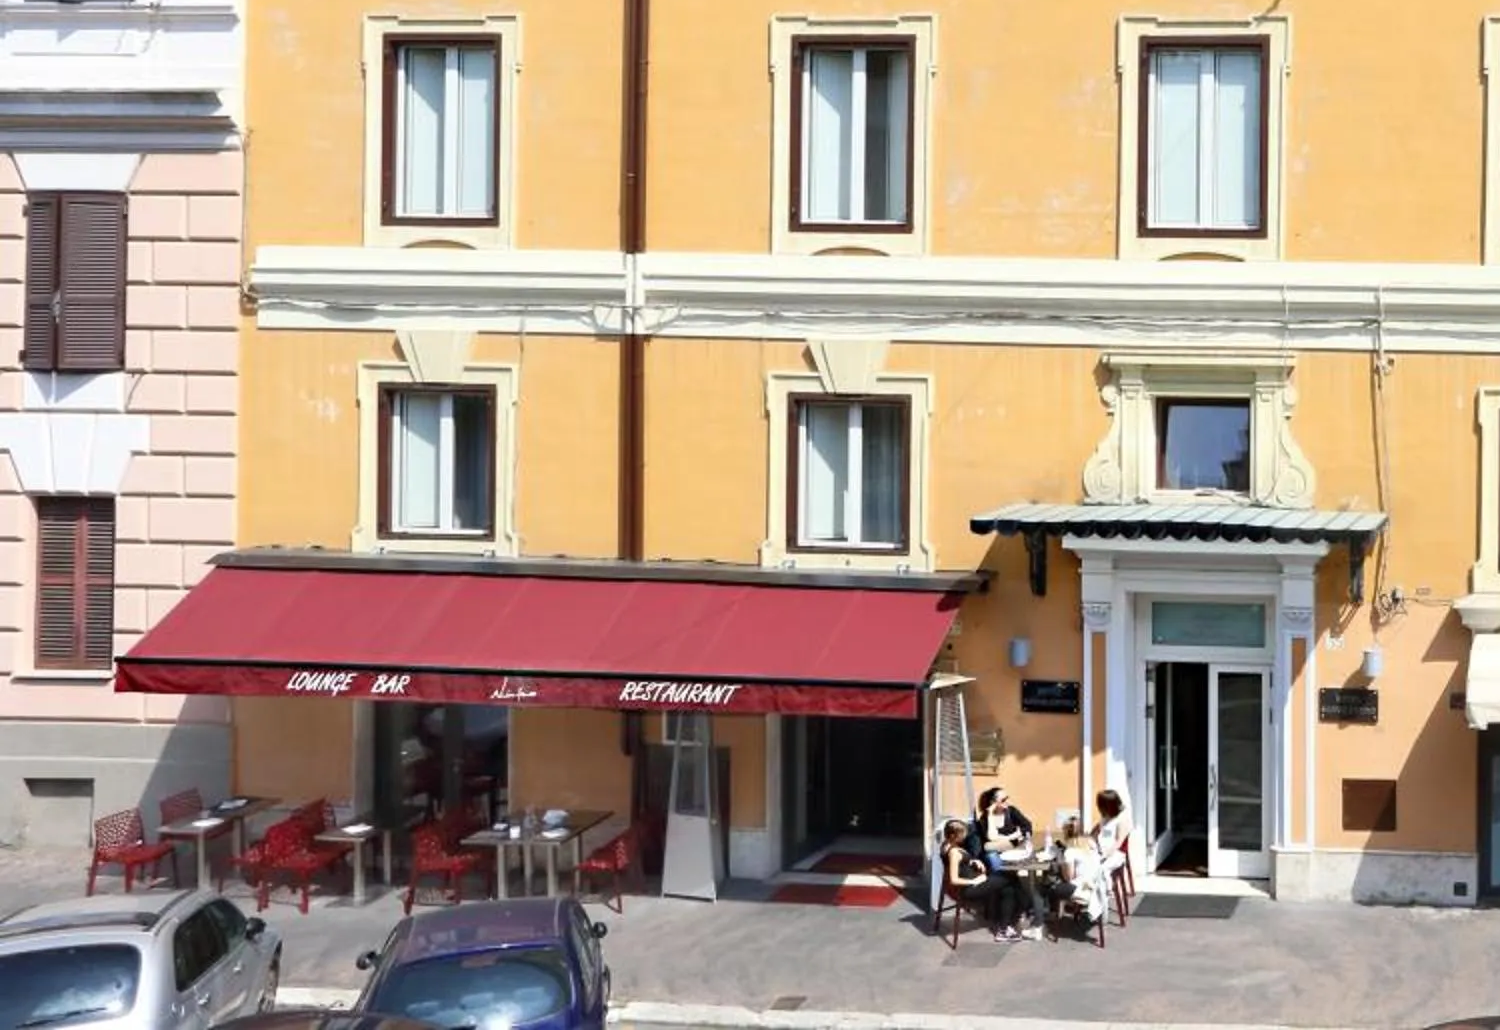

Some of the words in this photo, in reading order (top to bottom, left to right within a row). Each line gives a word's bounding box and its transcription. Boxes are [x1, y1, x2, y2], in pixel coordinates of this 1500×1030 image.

[286, 671, 357, 697] LOUNGE
[371, 674, 411, 694] BAR
[619, 681, 742, 705] RESTAURANT
